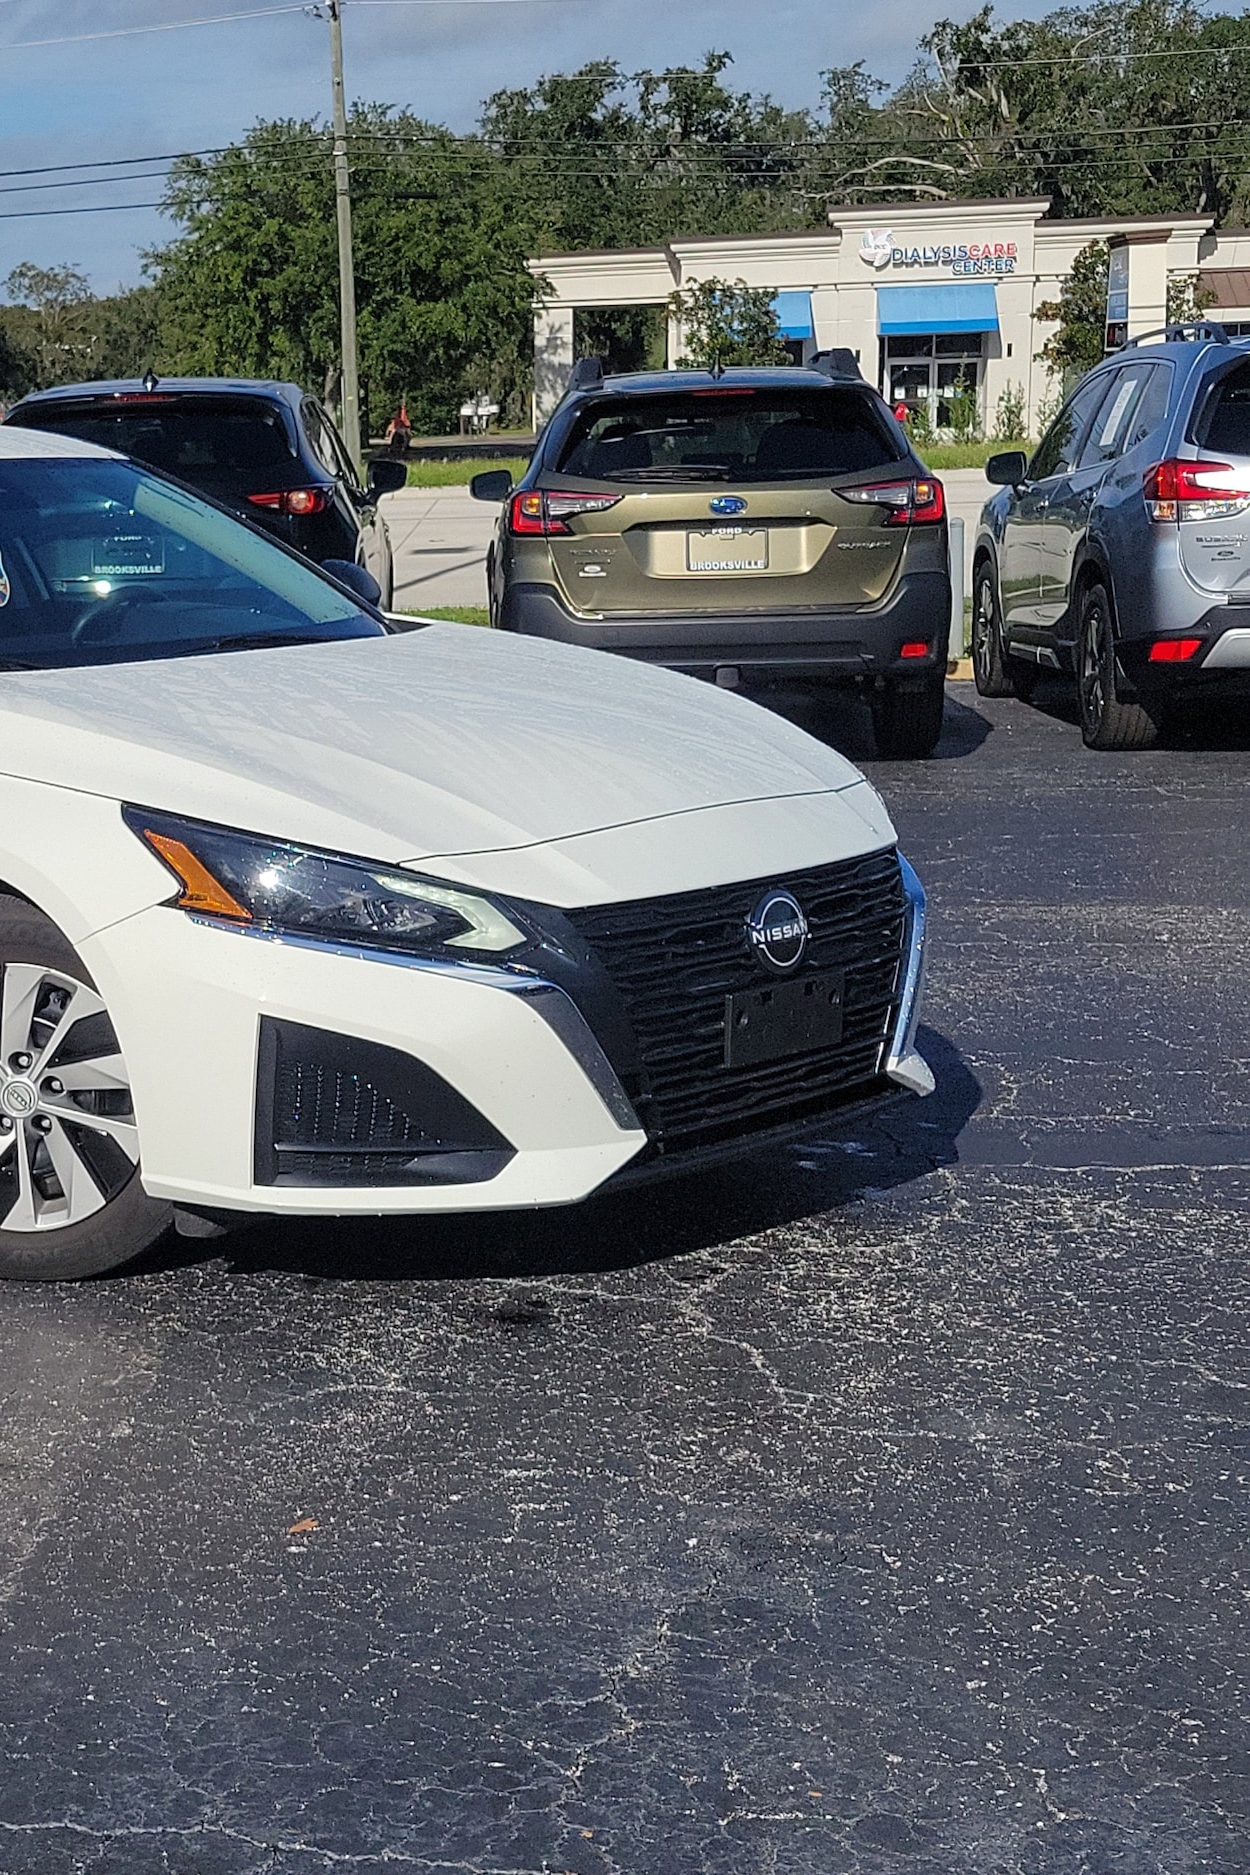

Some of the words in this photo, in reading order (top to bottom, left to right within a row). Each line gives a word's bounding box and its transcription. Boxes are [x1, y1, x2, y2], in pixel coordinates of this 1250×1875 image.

[952, 259, 1015, 274] CENTER
[711, 527, 743, 535] FORD
[94, 565, 163, 575] BROOKSVILLE
[690, 560, 765, 571] BROOKSVILLE
[751, 919, 808, 945] NISSAN
